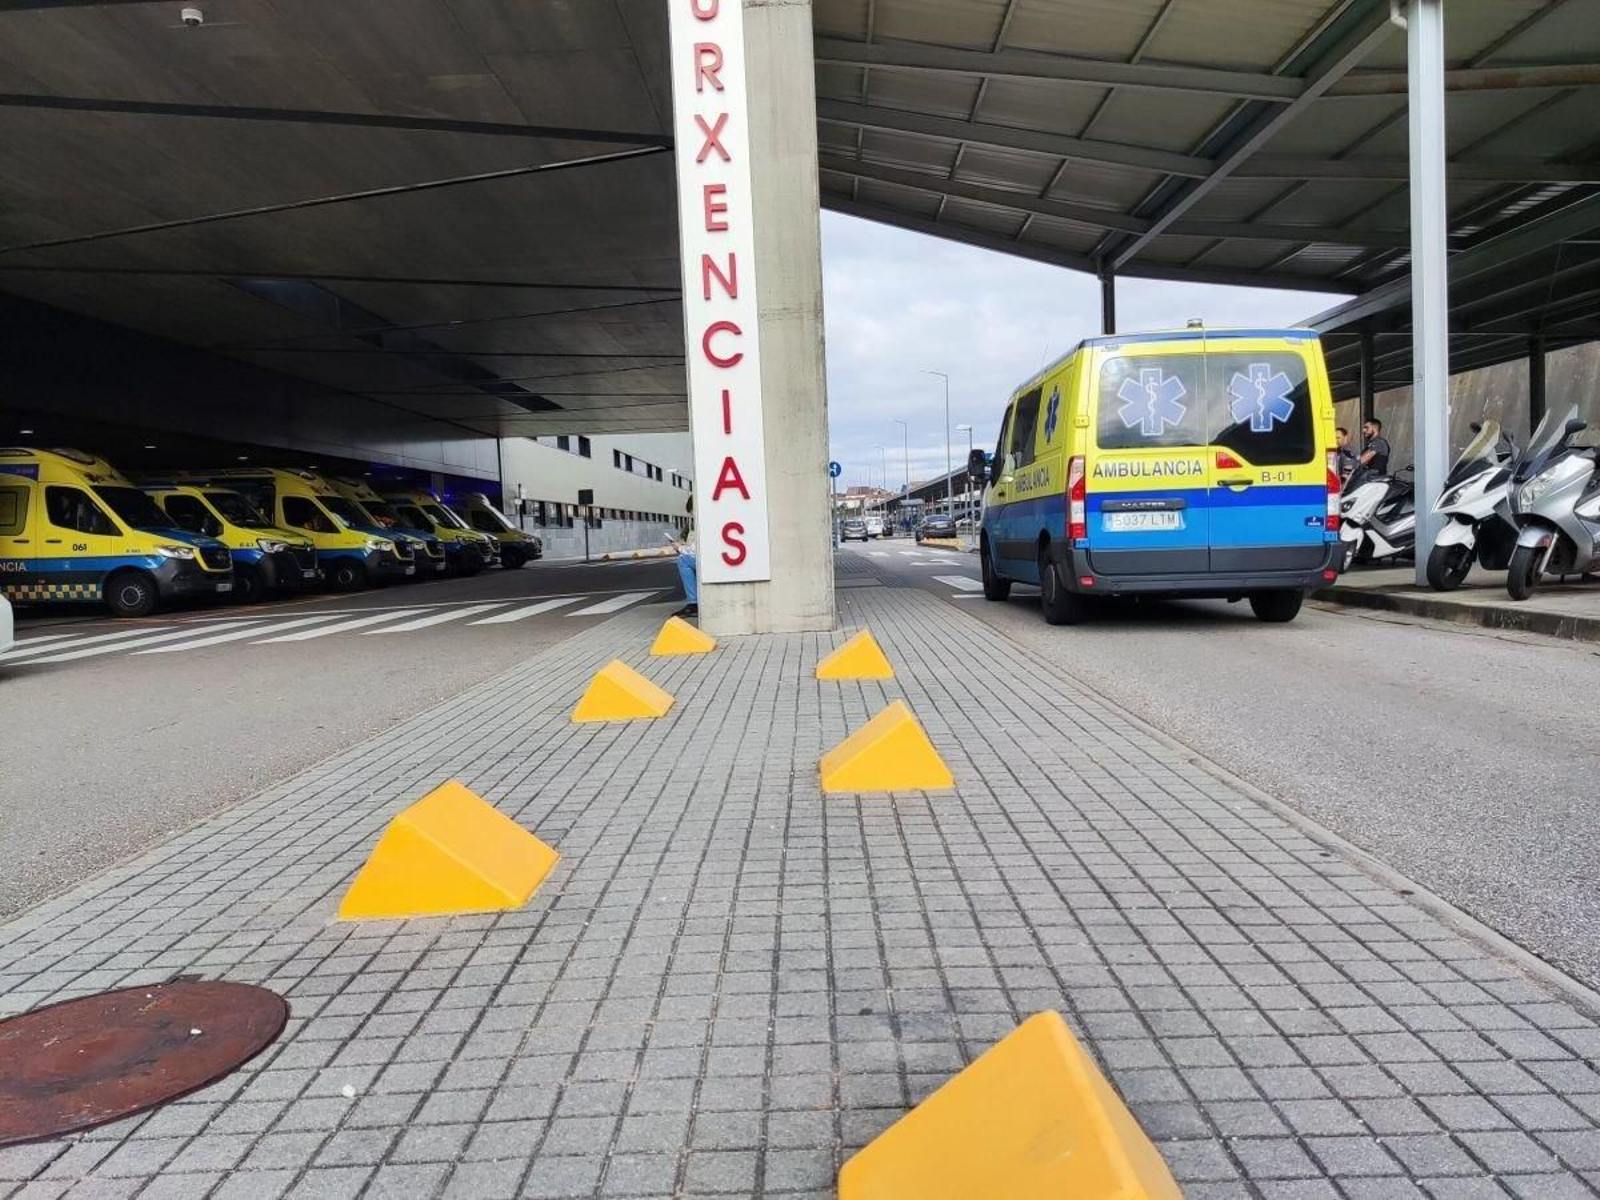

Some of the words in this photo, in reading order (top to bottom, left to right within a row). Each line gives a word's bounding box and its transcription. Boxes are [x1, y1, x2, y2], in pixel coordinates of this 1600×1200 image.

[1092, 459, 1203, 478] AMBULANCIA
[1262, 471, 1292, 482] B-01
[1115, 514, 1146, 526] 5037
[1151, 513, 1175, 526] LTM
